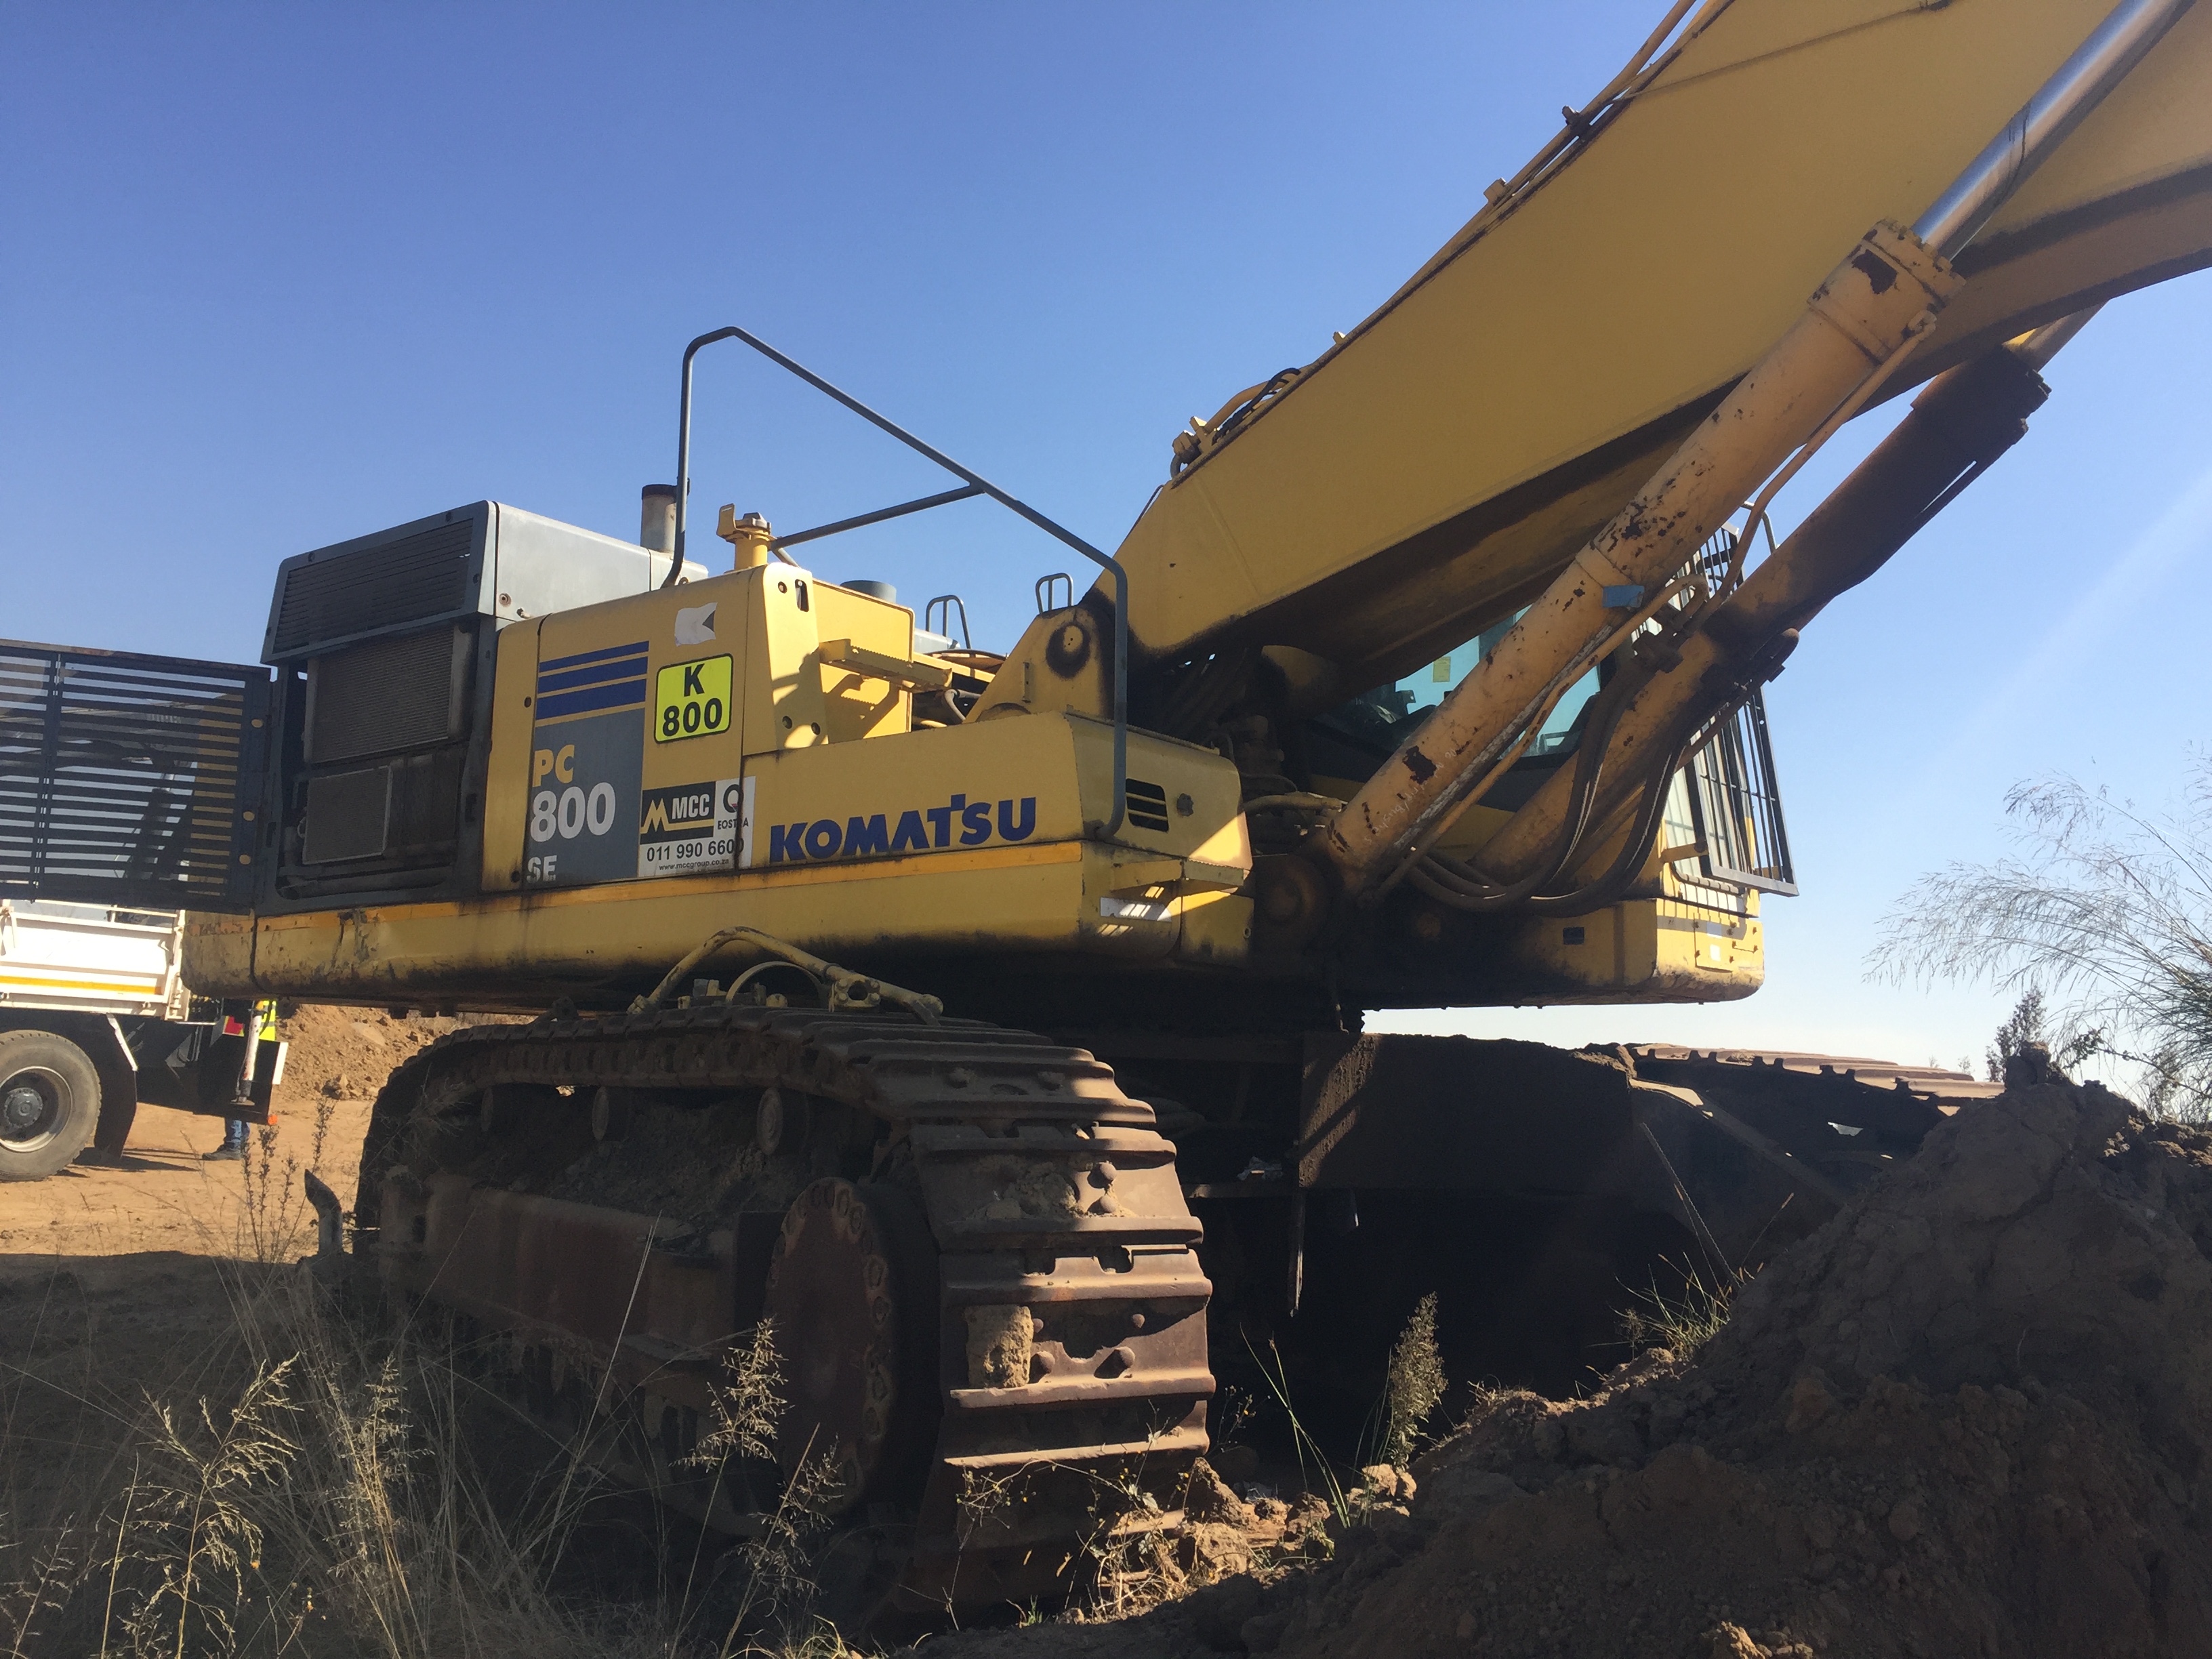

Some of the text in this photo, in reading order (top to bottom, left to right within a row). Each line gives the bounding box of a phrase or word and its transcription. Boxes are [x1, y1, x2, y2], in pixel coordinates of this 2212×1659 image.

[684, 663, 705, 697] K
[662, 697, 722, 737] 800
[533, 744, 575, 787] PC
[530, 782, 616, 842] 800
[672, 794, 710, 820] MCC
[718, 817, 749, 830] EOSTA
[769, 793, 1036, 863] KOMATSU
[526, 855, 557, 882] SE
[647, 845, 670, 862] 011
[676, 842, 703, 859] 990
